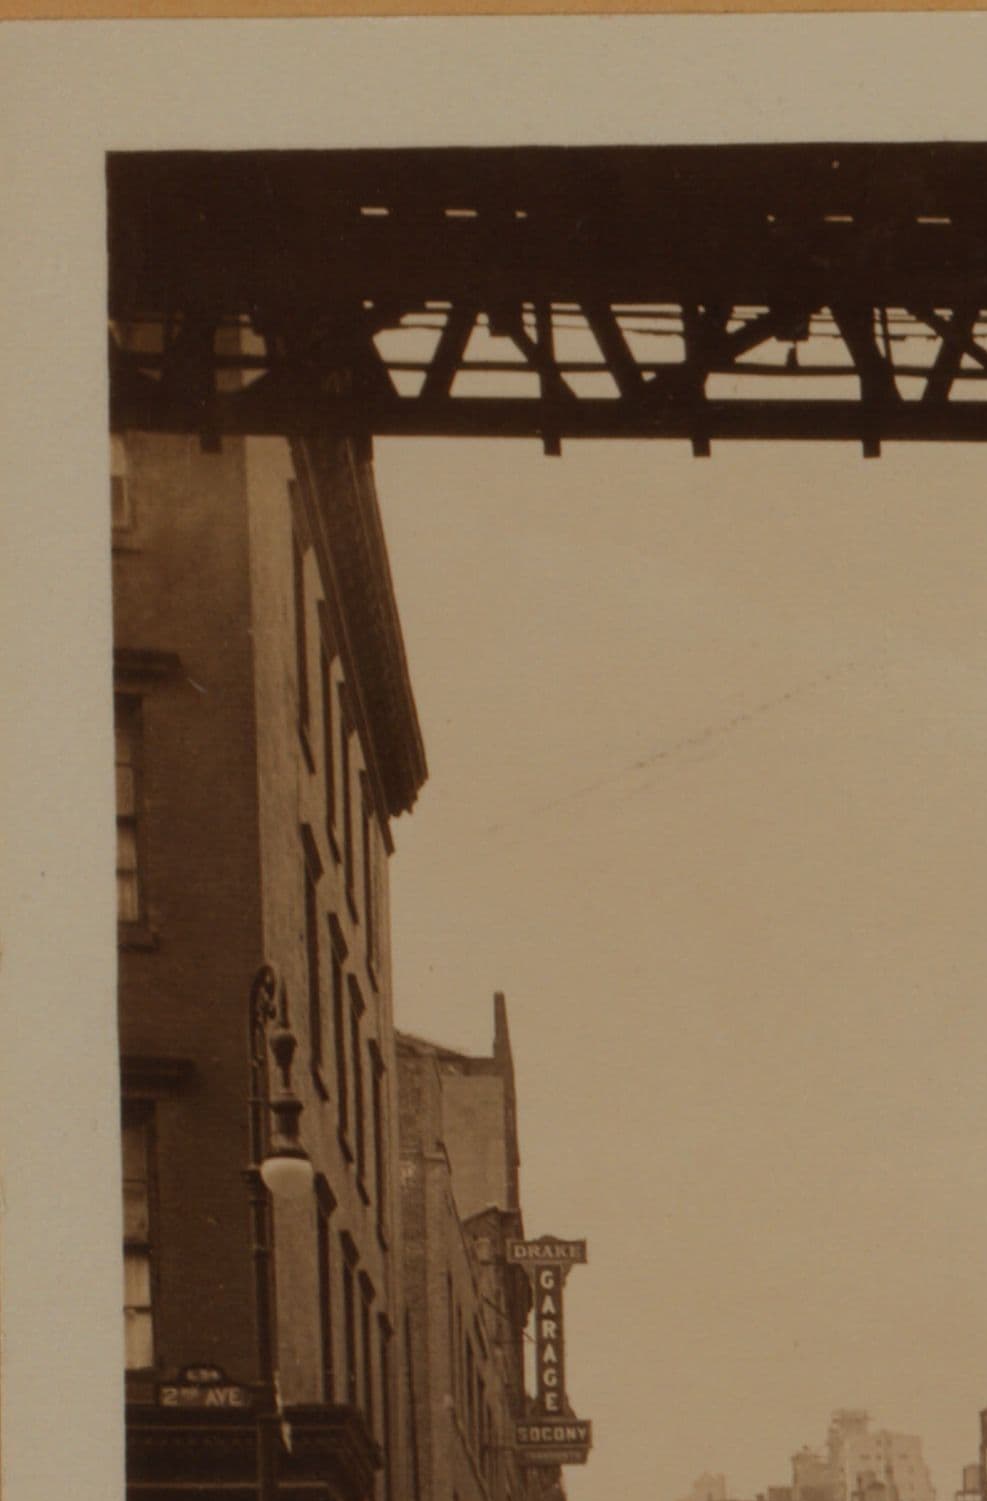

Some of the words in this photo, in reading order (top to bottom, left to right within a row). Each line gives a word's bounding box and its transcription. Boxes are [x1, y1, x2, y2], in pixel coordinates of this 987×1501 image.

[514, 1245, 581, 1259] DRAKE
[540, 1270, 559, 1411] GARAGE
[517, 1426, 587, 1443] SOCONY
